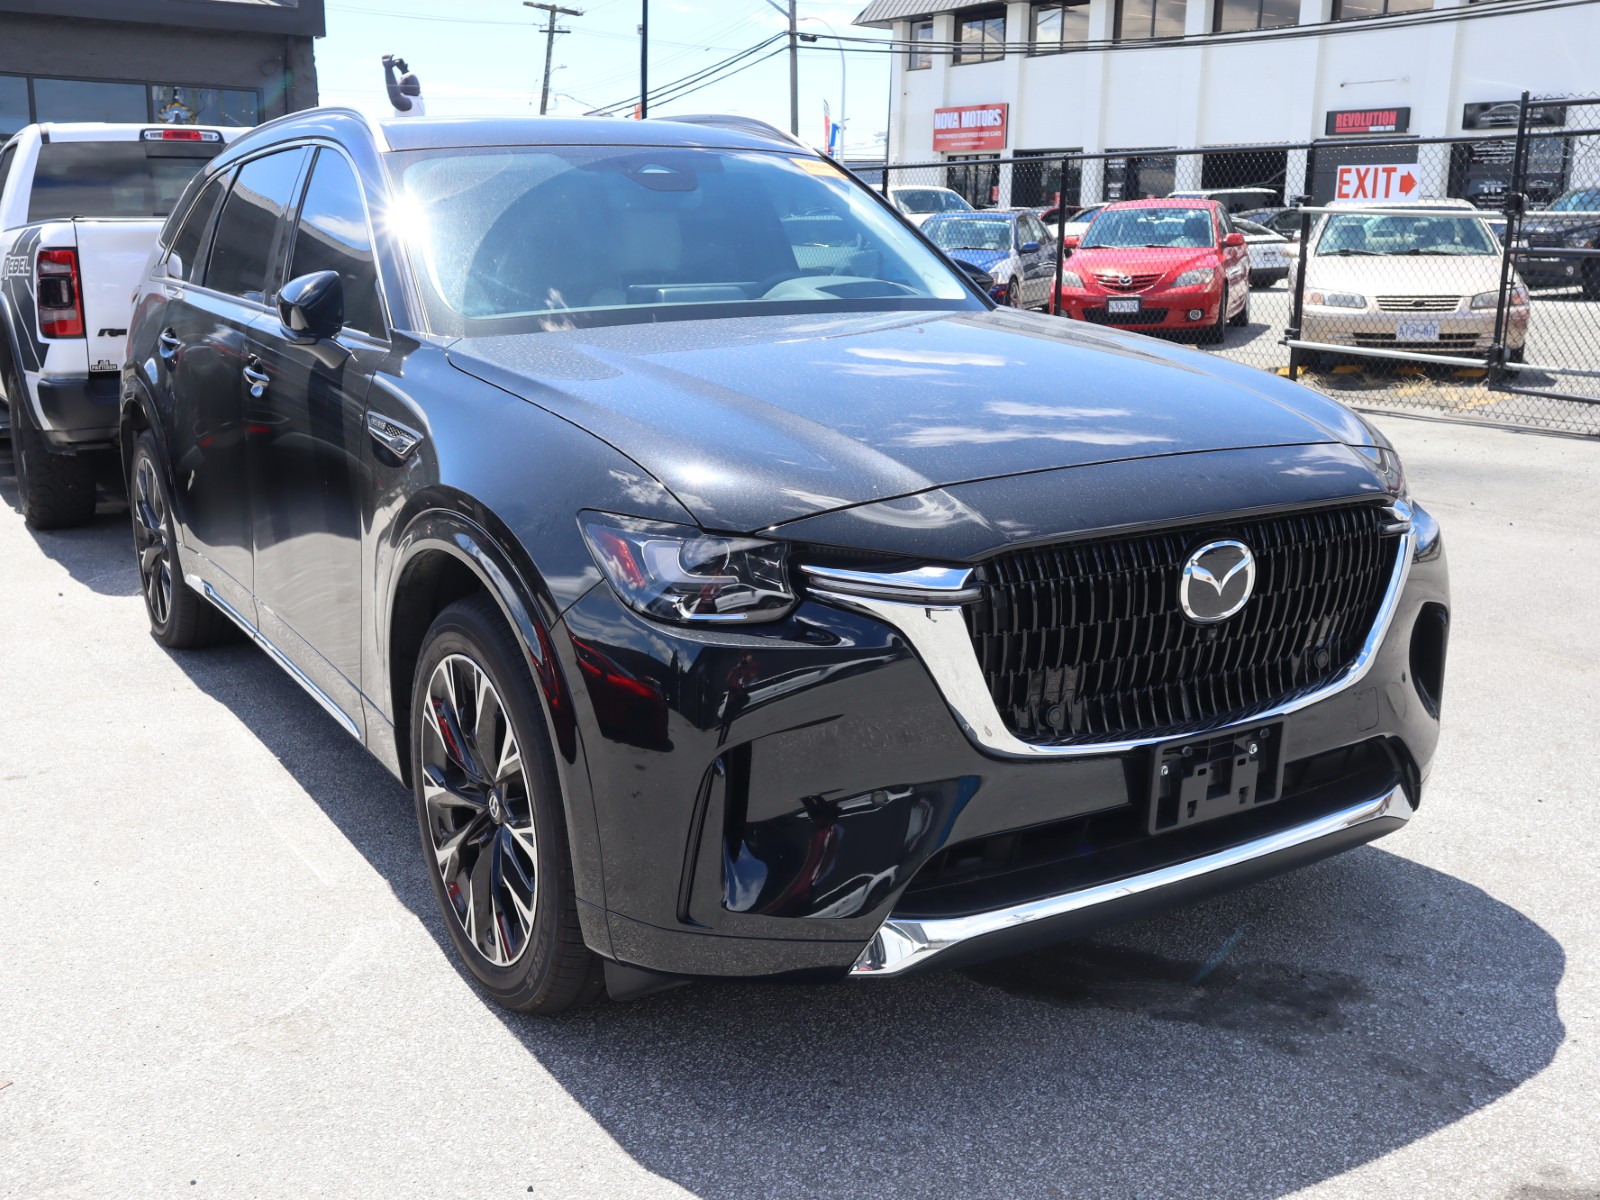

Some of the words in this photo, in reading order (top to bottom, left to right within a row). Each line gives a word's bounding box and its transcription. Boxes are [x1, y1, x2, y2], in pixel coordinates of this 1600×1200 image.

[935, 112, 960, 129] NOVA
[961, 108, 1003, 128] MOTORS
[1335, 110, 1397, 128] REVOLUTION
[1337, 166, 1397, 199] EXIT
[4, 255, 31, 280] REBEL
